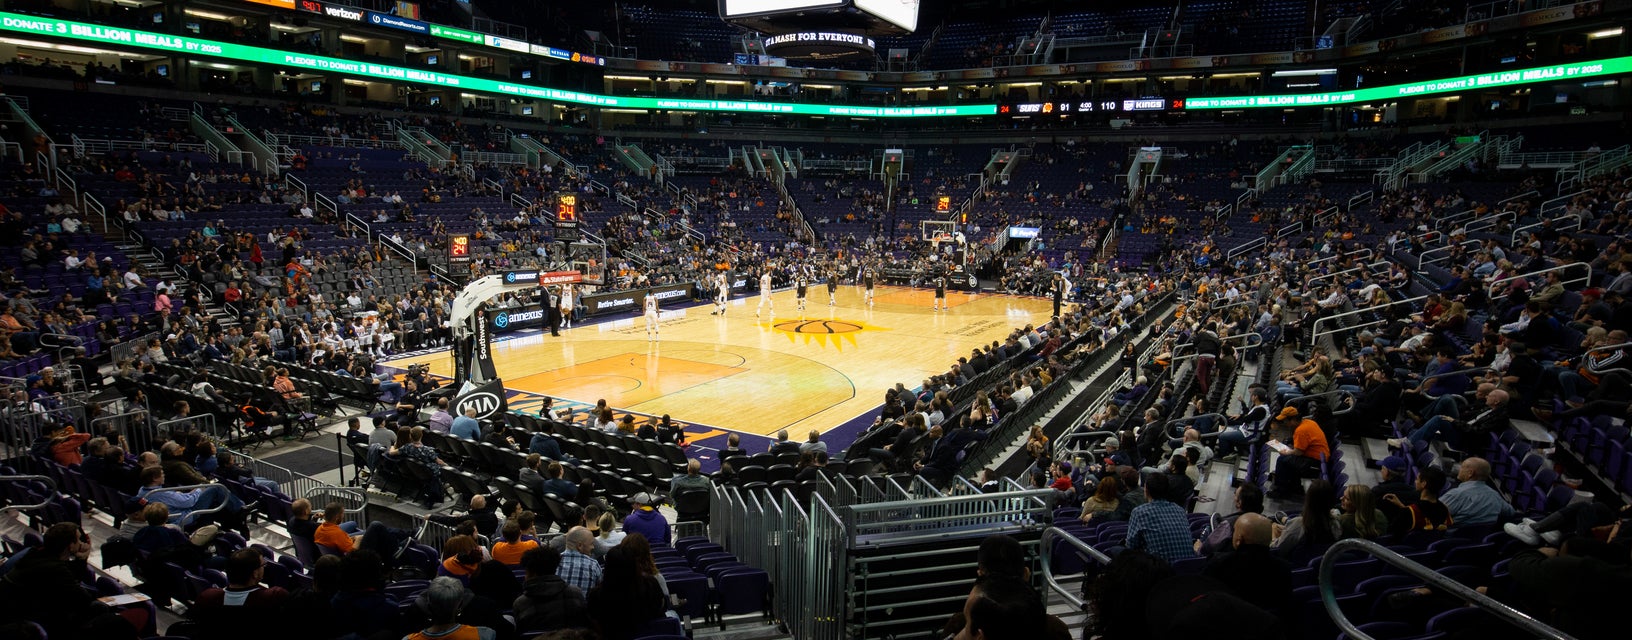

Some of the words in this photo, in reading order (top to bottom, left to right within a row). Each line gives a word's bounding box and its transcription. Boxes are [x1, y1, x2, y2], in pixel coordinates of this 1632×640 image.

[326, 7, 360, 20] verizon
[4, 18, 53, 31] DONATE
[57, 23, 66, 33] 3
[71, 24, 131, 41] BILLION
[135, 33, 183, 48] MEALS
[186, 42, 199, 50] BY
[201, 44, 221, 53] 2025
[775, 35, 796, 43] MASH
[819, 33, 863, 44] EVERYONE
[286, 56, 316, 66] PLEDGE
[330, 62, 358, 71] DONATE
[360, 64, 366, 72] 3
[369, 66, 404, 77] BILLION
[407, 70, 436, 82] MEALS
[1400, 85, 1425, 94] PLEDGE
[1437, 80, 1466, 89] DONATE
[1468, 78, 1474, 86] 3
[1477, 72, 1520, 85] BILLION
[1523, 67, 1564, 80] MEALS
[1567, 67, 1580, 75] BY
[1582, 65, 1602, 73] 2025
[1019, 104, 1040, 112] SUNS
[1061, 103, 1070, 111] 91
[1101, 102, 1115, 110] 110
[1173, 100, 1183, 108] 24
[1257, 96, 1294, 105] BILLION
[1297, 95, 1329, 103] MEALS
[560, 196, 575, 205] 4:00
[938, 202, 948, 210] 24
[559, 205, 574, 221] 24
[453, 245, 465, 255] 24
[598, 301, 613, 309] Retire
[509, 310, 543, 322] annexus
[463, 397, 495, 413] KIA
